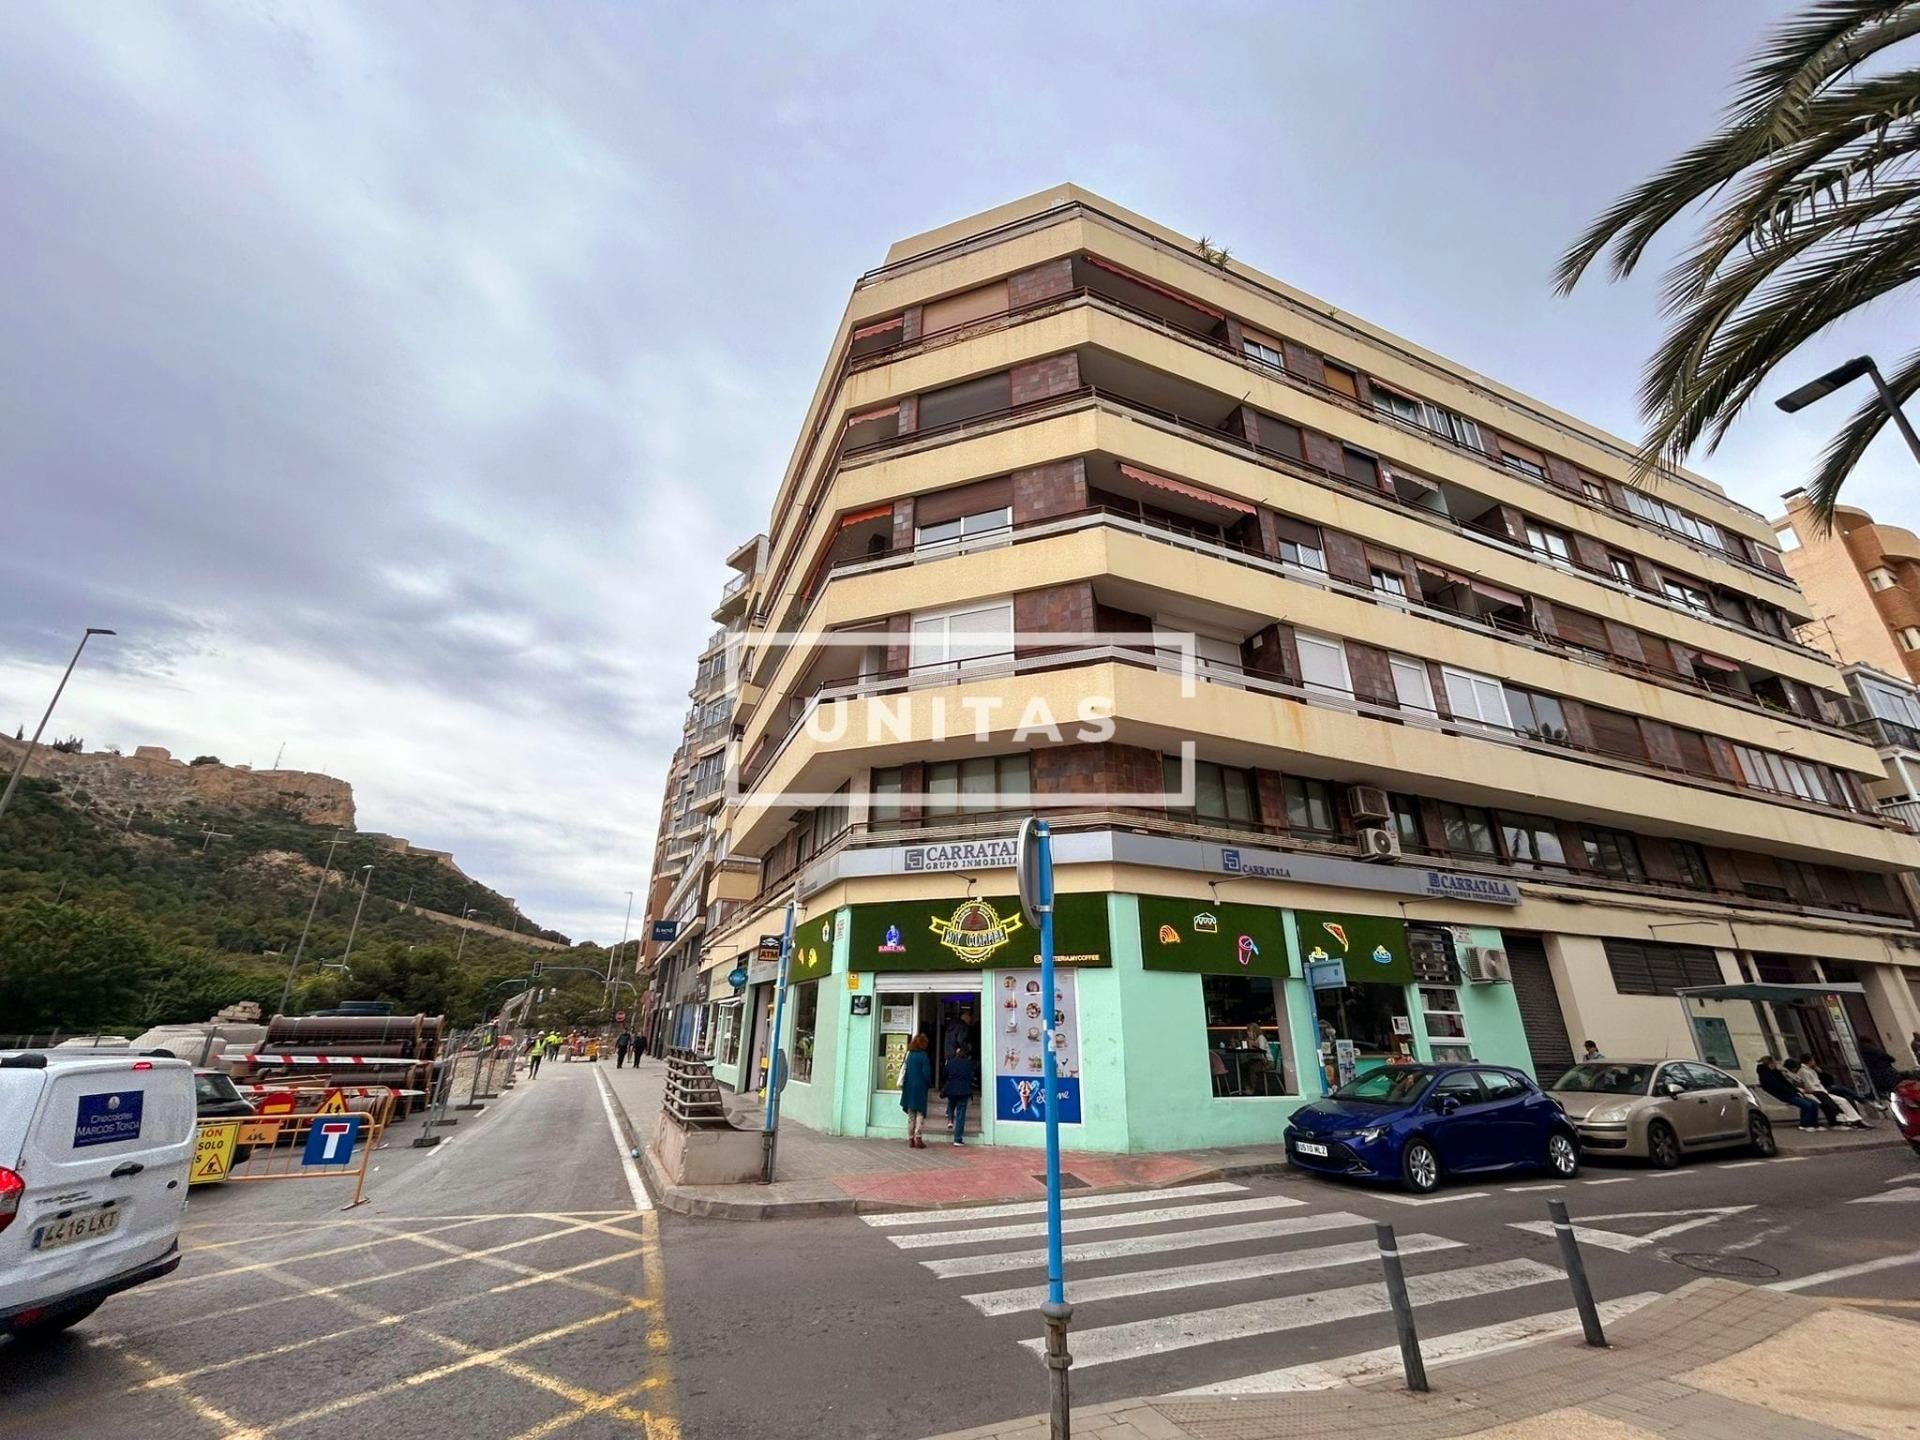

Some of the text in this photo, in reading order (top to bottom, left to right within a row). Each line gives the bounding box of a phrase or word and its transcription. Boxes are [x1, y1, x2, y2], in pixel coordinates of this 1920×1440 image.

[925, 857, 1018, 870] GRUPO INMOBILIA
[1242, 864, 1291, 878] CARRATALA
[1441, 875, 1511, 896] CARRATALA
[760, 951, 778, 959] ATM
[77, 1124, 115, 1137] MARCOS
[197, 1140, 224, 1151] SOLO
[88, 1211, 117, 1232] LKT
